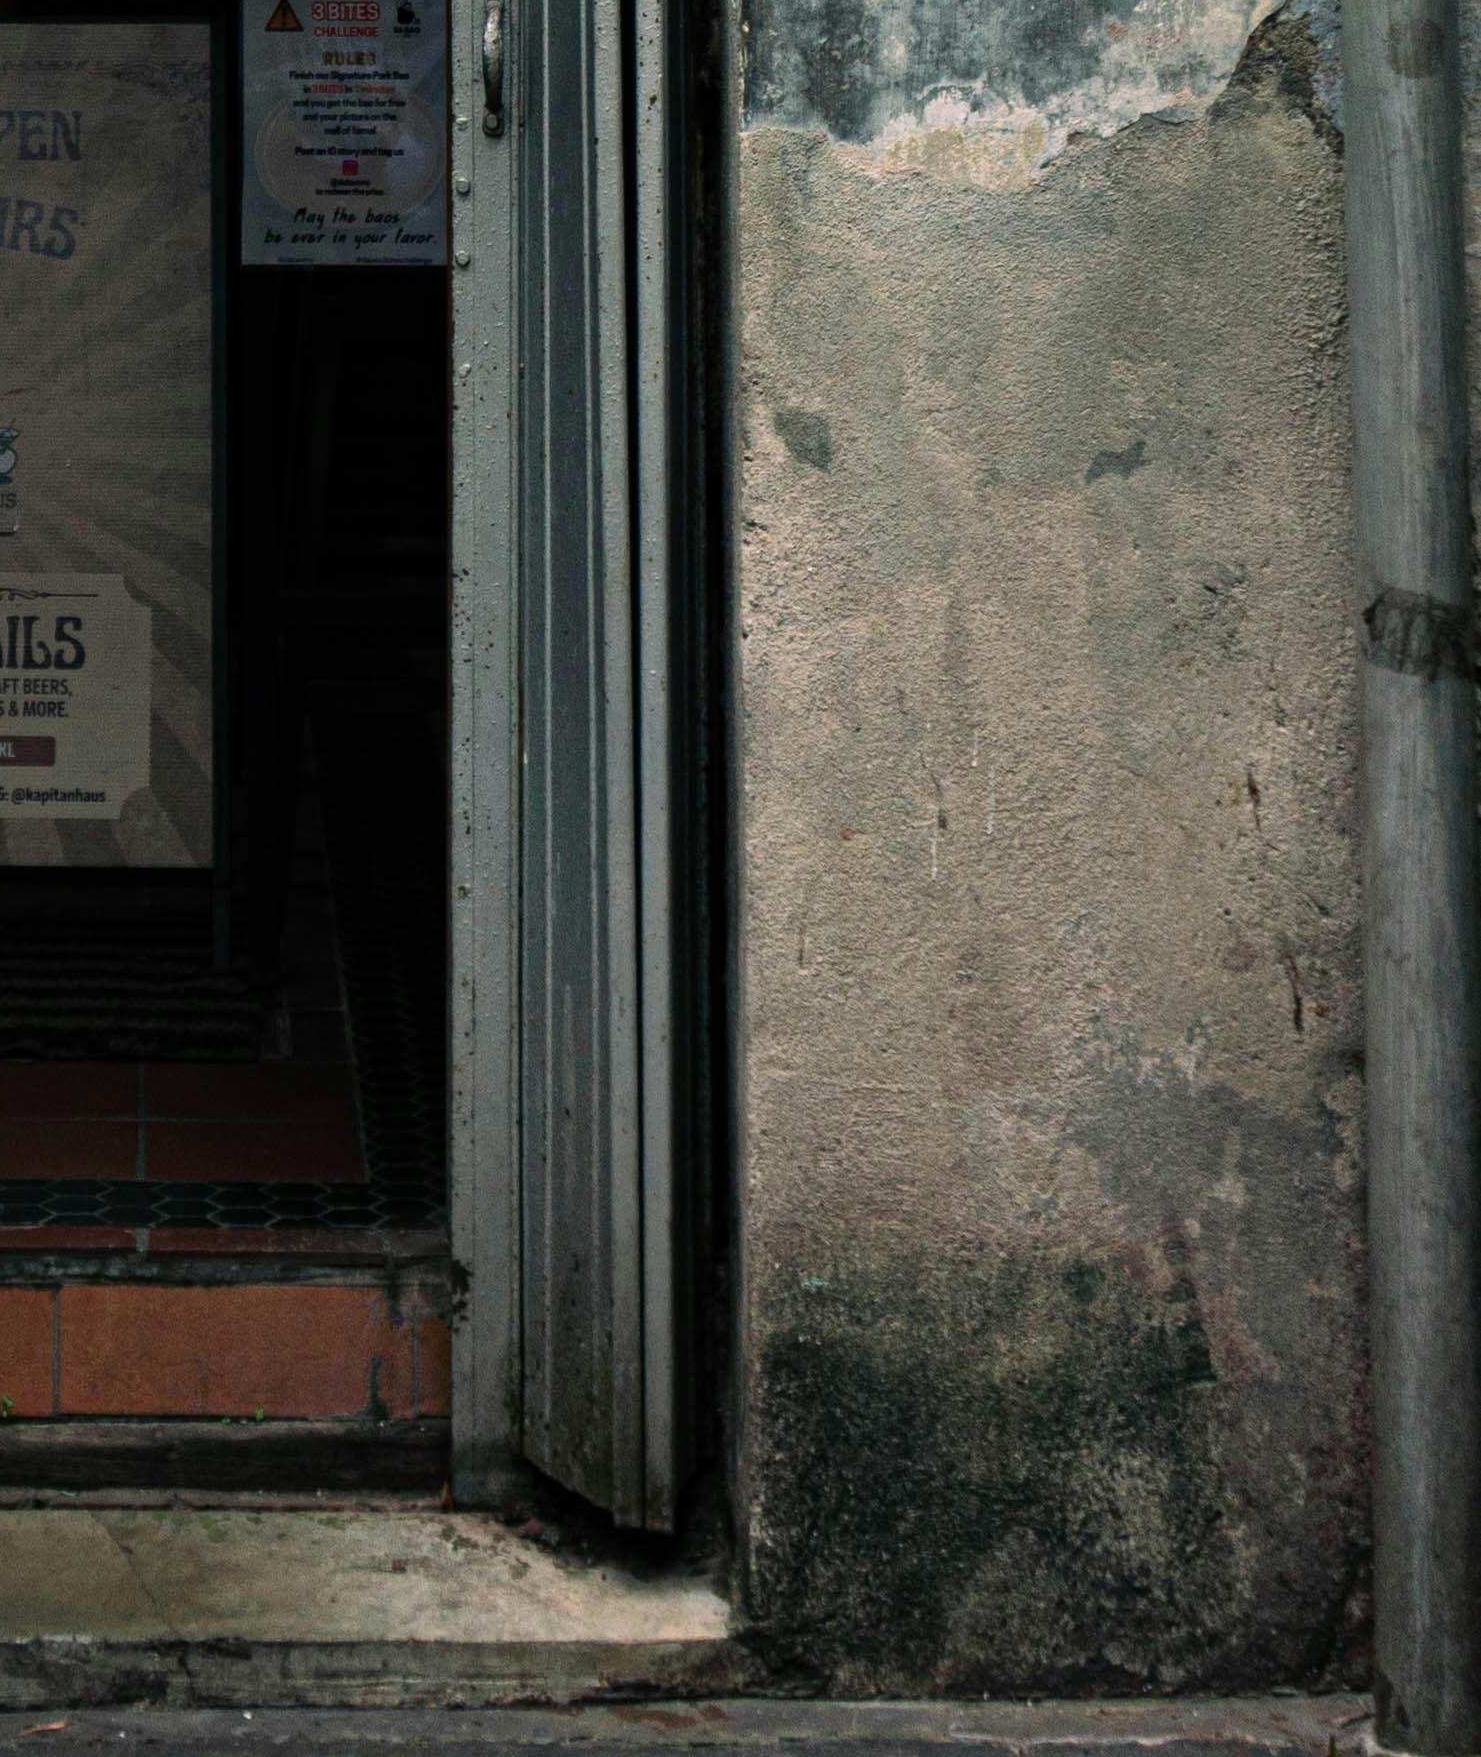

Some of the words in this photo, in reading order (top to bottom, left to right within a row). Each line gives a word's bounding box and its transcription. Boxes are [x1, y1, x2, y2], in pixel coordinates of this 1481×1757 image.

[311, 1, 326, 22] 3
[327, 1, 380, 22] BITES
[314, 26, 379, 38] CHALLENGE
[323, 51, 376, 65] RULES
[289, 71, 313, 80] Finish
[330, 71, 372, 82] Signature
[294, 207, 325, 229] May
[333, 207, 357, 224] the
[365, 208, 400, 224] baos
[264, 229, 283, 243] be
[292, 233, 325, 243] ever
[333, 232, 346, 243] in
[355, 234, 386, 249] your
[395, 228, 437, 244] favor.
[23, 678, 73, 697] BEERS,
[9, 701, 19, 717] &
[23, 701, 70, 718] MORE.
[11, 786, 106, 806] @kapitanhaus
